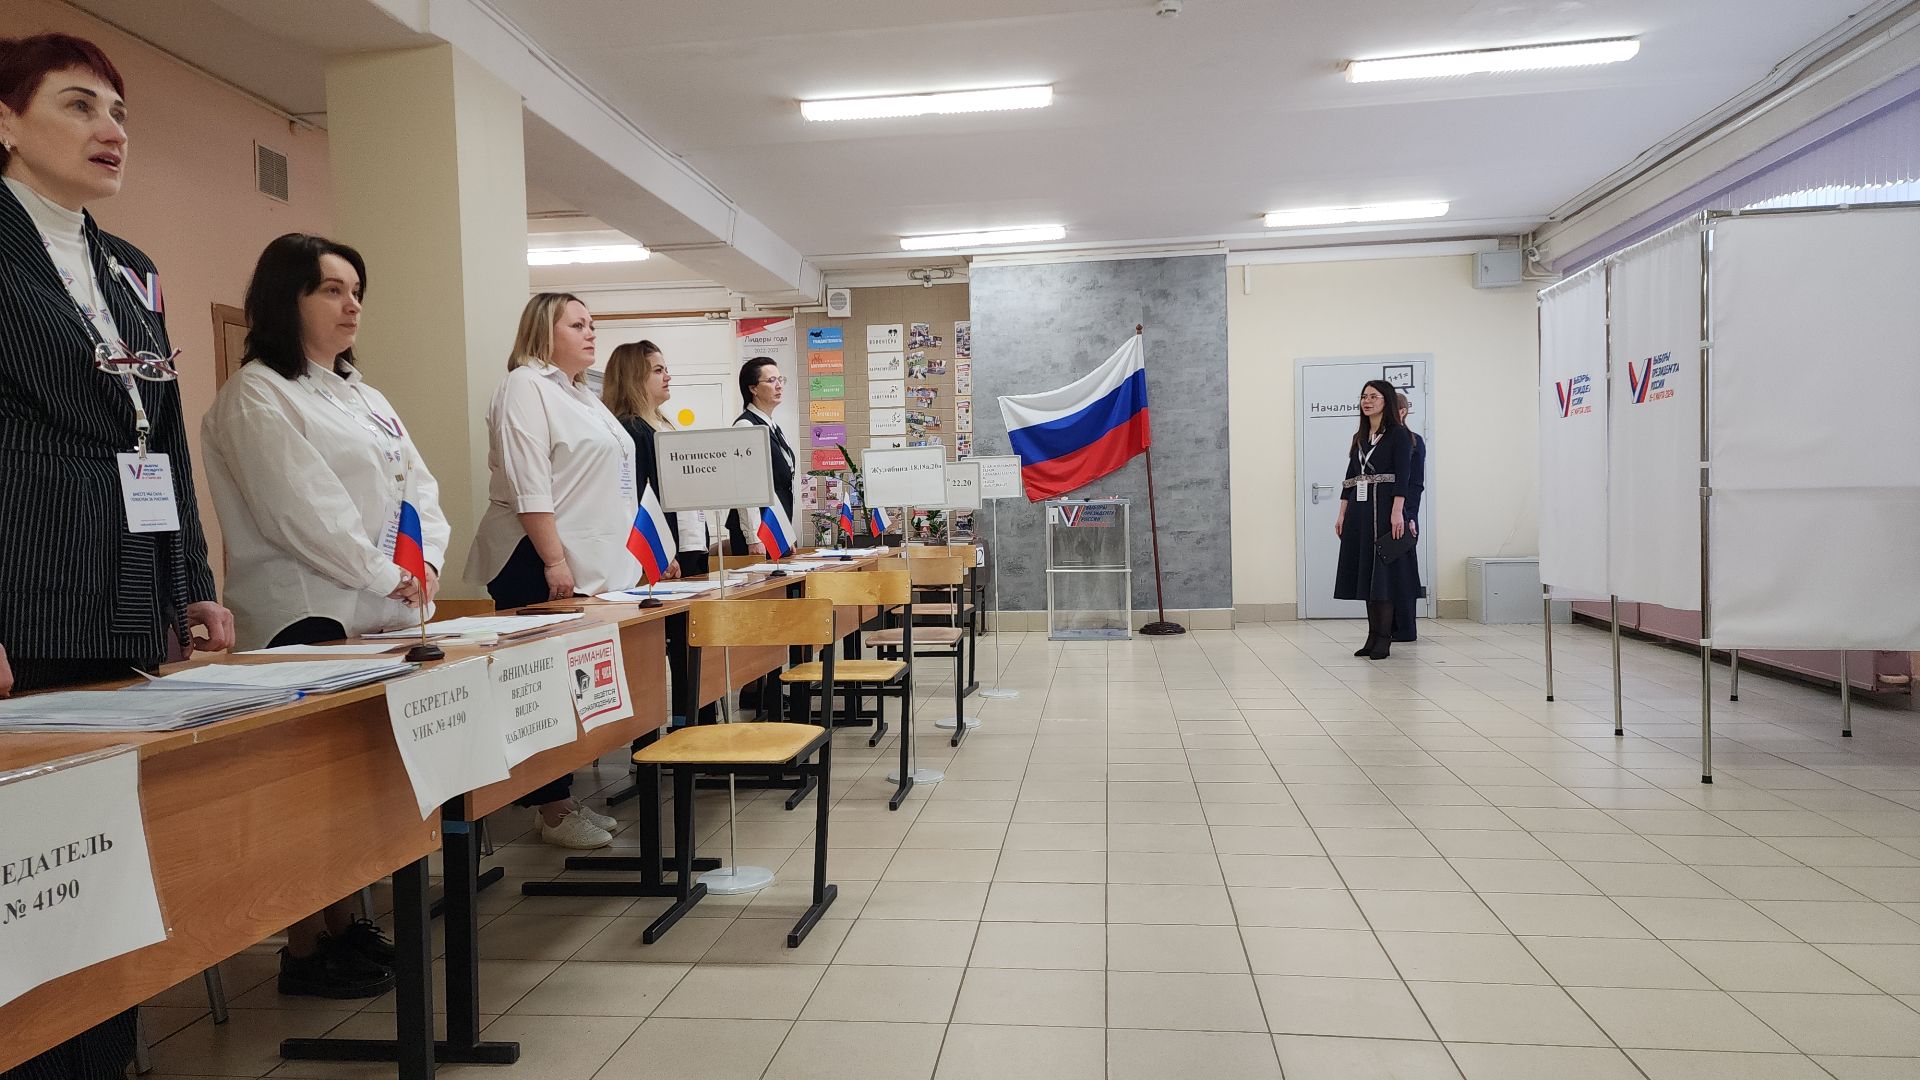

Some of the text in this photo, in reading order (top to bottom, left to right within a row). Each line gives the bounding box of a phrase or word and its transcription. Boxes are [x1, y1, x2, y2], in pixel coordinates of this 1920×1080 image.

[1311, 403, 1360, 413] Начальн
[670, 451, 728, 462] Ногинское
[745, 447, 752, 457] 6
[682, 465, 717, 475] Шоссе
[570, 647, 612, 667] ВНИМАНИЕ!
[499, 657, 554, 682] «ВНИМАНИЕ!
[511, 681, 542, 699] ВЕДЁТСЯ
[404, 686, 469, 718] СЕКРЕТАРЬ
[412, 722, 436, 742] УИК
[448, 711, 466, 728] 4190
[1, 832, 113, 886] ЕДАТЕЛЬ
[3, 879, 80, 924] № 4190
